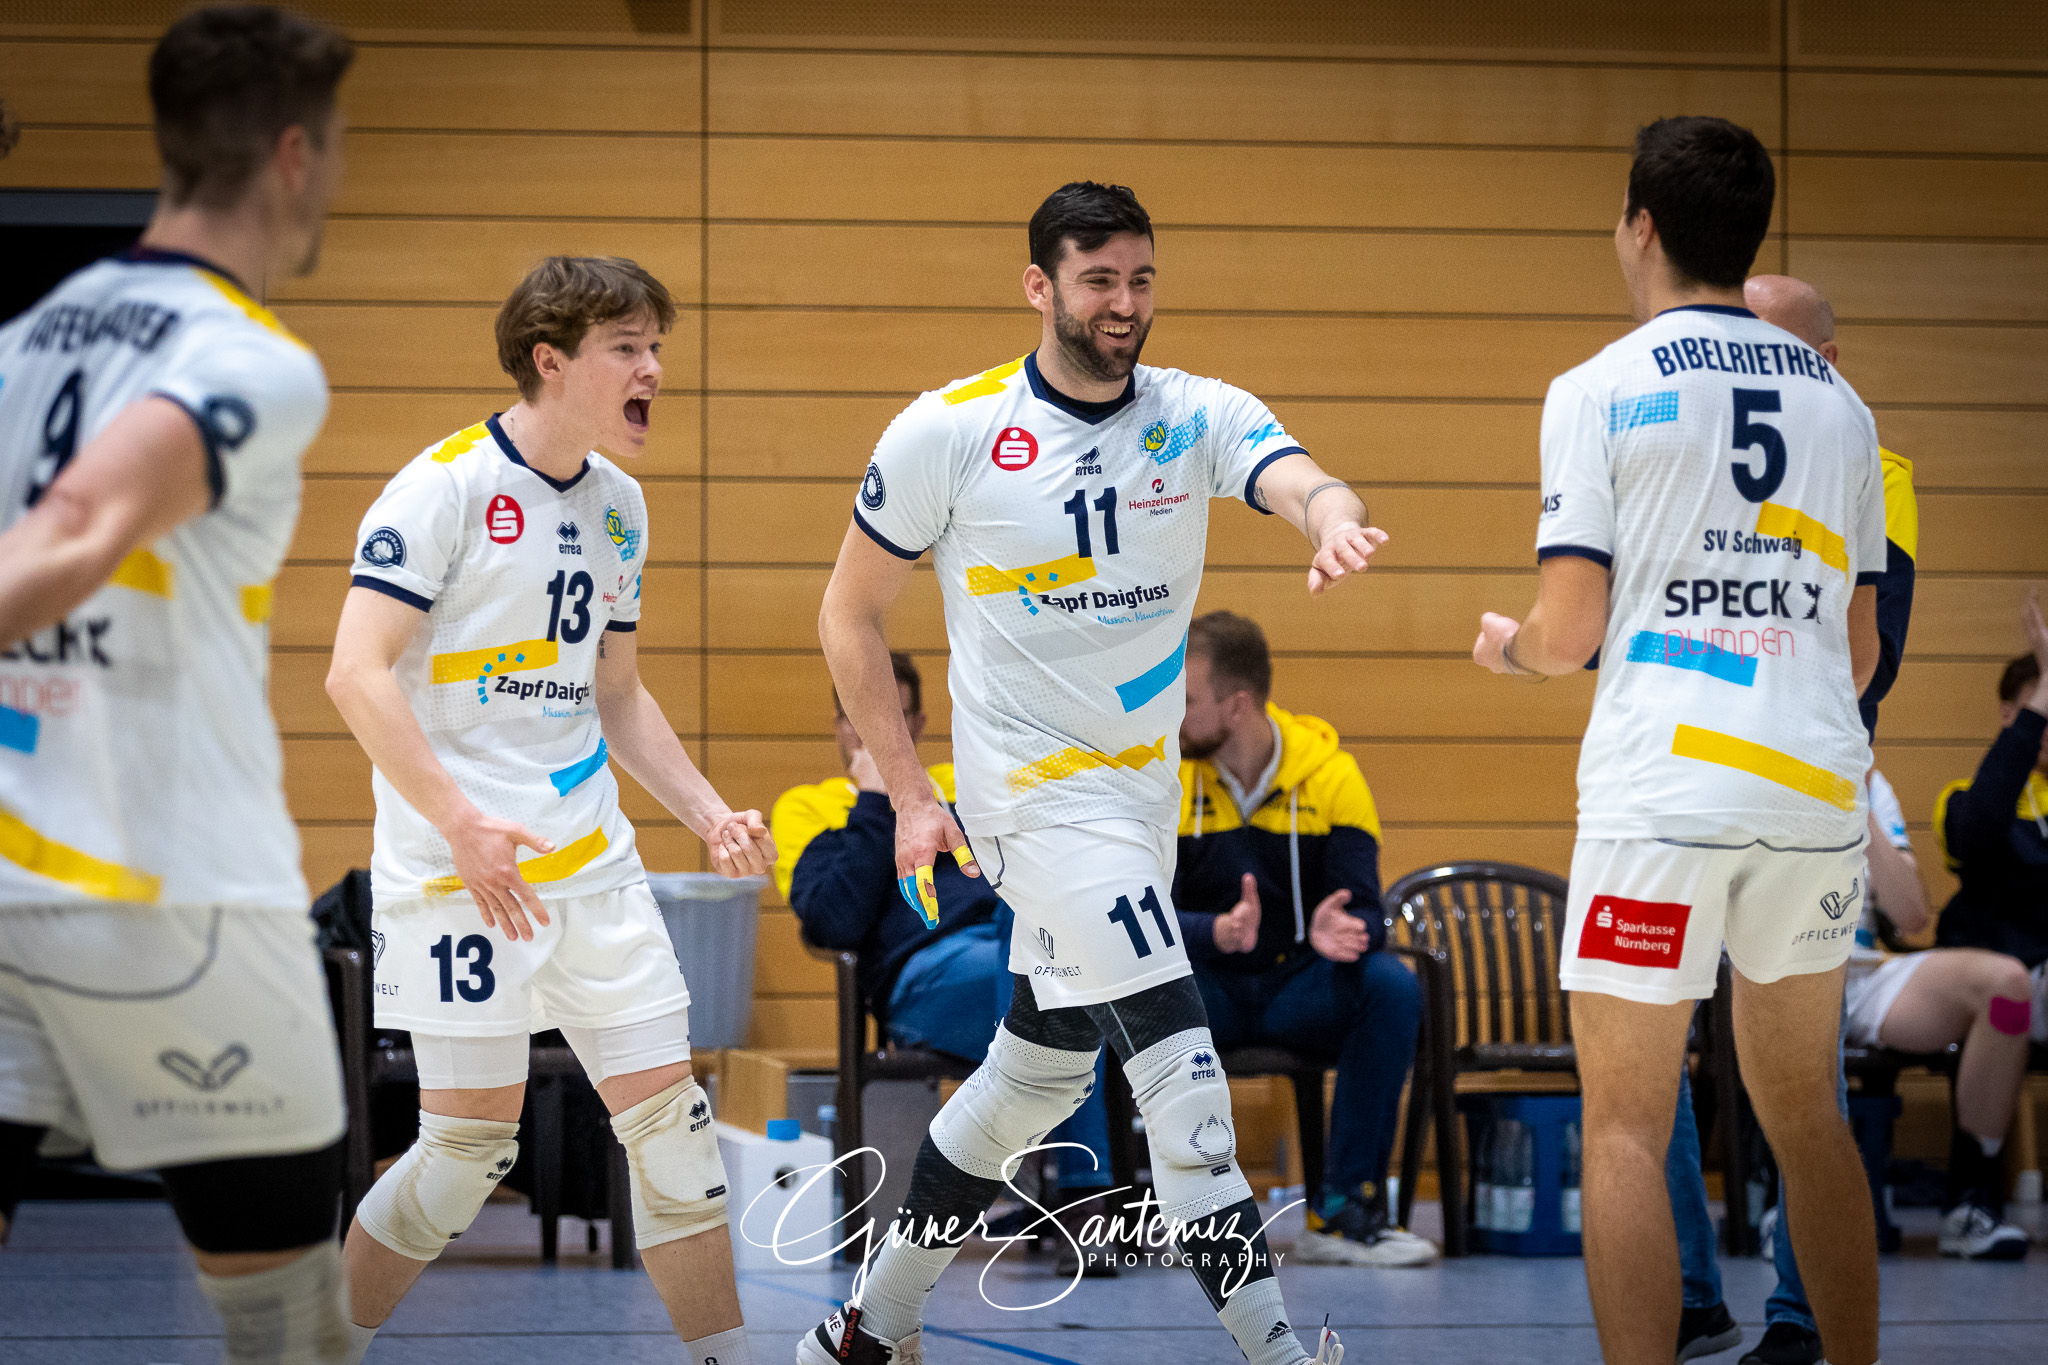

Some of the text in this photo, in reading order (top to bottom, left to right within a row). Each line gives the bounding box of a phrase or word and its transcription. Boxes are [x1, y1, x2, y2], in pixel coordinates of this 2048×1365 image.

[1652, 337, 1834, 385] BIBELRIETHER
[1731, 387, 1787, 503] 5
[1129, 493, 1189, 510] Heinzelmann
[1150, 508, 1173, 516] Medien
[1064, 487, 1120, 558] 11
[1704, 530, 1802, 559] SV Schwaig
[546, 570, 594, 644] 13
[1037, 584, 1169, 613] Zapf Daigfuss
[1665, 579, 1792, 618] SPECK
[1665, 627, 1795, 665] pumpen
[494, 676, 544, 700] Zapf
[1107, 885, 1176, 959] 11
[1616, 919, 1676, 936] Sparkasse
[1615, 936, 1670, 954] Nürnberg
[430, 934, 496, 1003] 13
